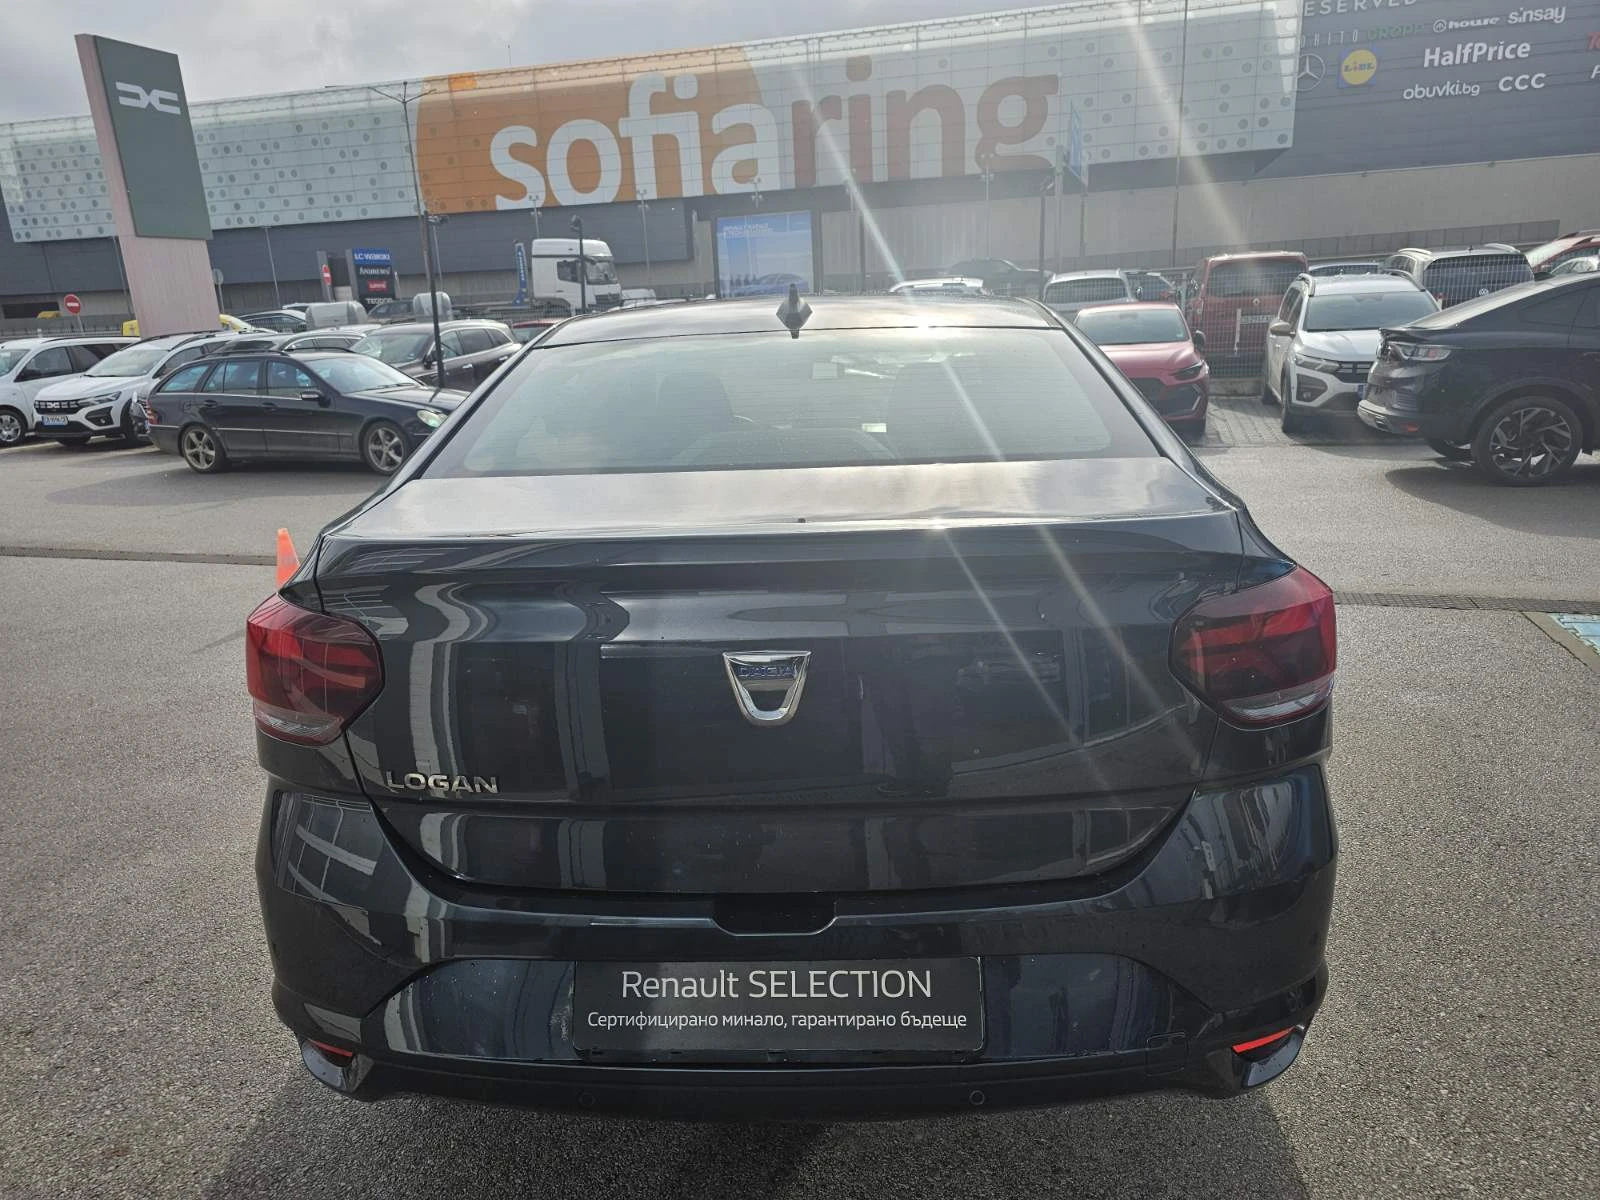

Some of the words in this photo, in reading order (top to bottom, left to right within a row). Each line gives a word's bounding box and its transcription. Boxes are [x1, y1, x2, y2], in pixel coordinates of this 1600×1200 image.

[1508, 6, 1566, 25] sinsay
[1423, 41, 1531, 68] HalfPrice
[1403, 80, 1480, 100] obuvki.bg
[1499, 72, 1546, 92] CCC
[489, 54, 1060, 211] sofiaring
[739, 667, 793, 677] DACIA
[386, 771, 498, 793] LOGAN
[622, 970, 739, 998] Renault
[749, 970, 932, 998] SELECTION
[587, 1011, 718, 1030] Сертифицирано
[722, 1013, 788, 1029] минало,
[792, 1014, 896, 1030] гарантирано
[900, 1011, 967, 1029] бъдеще
